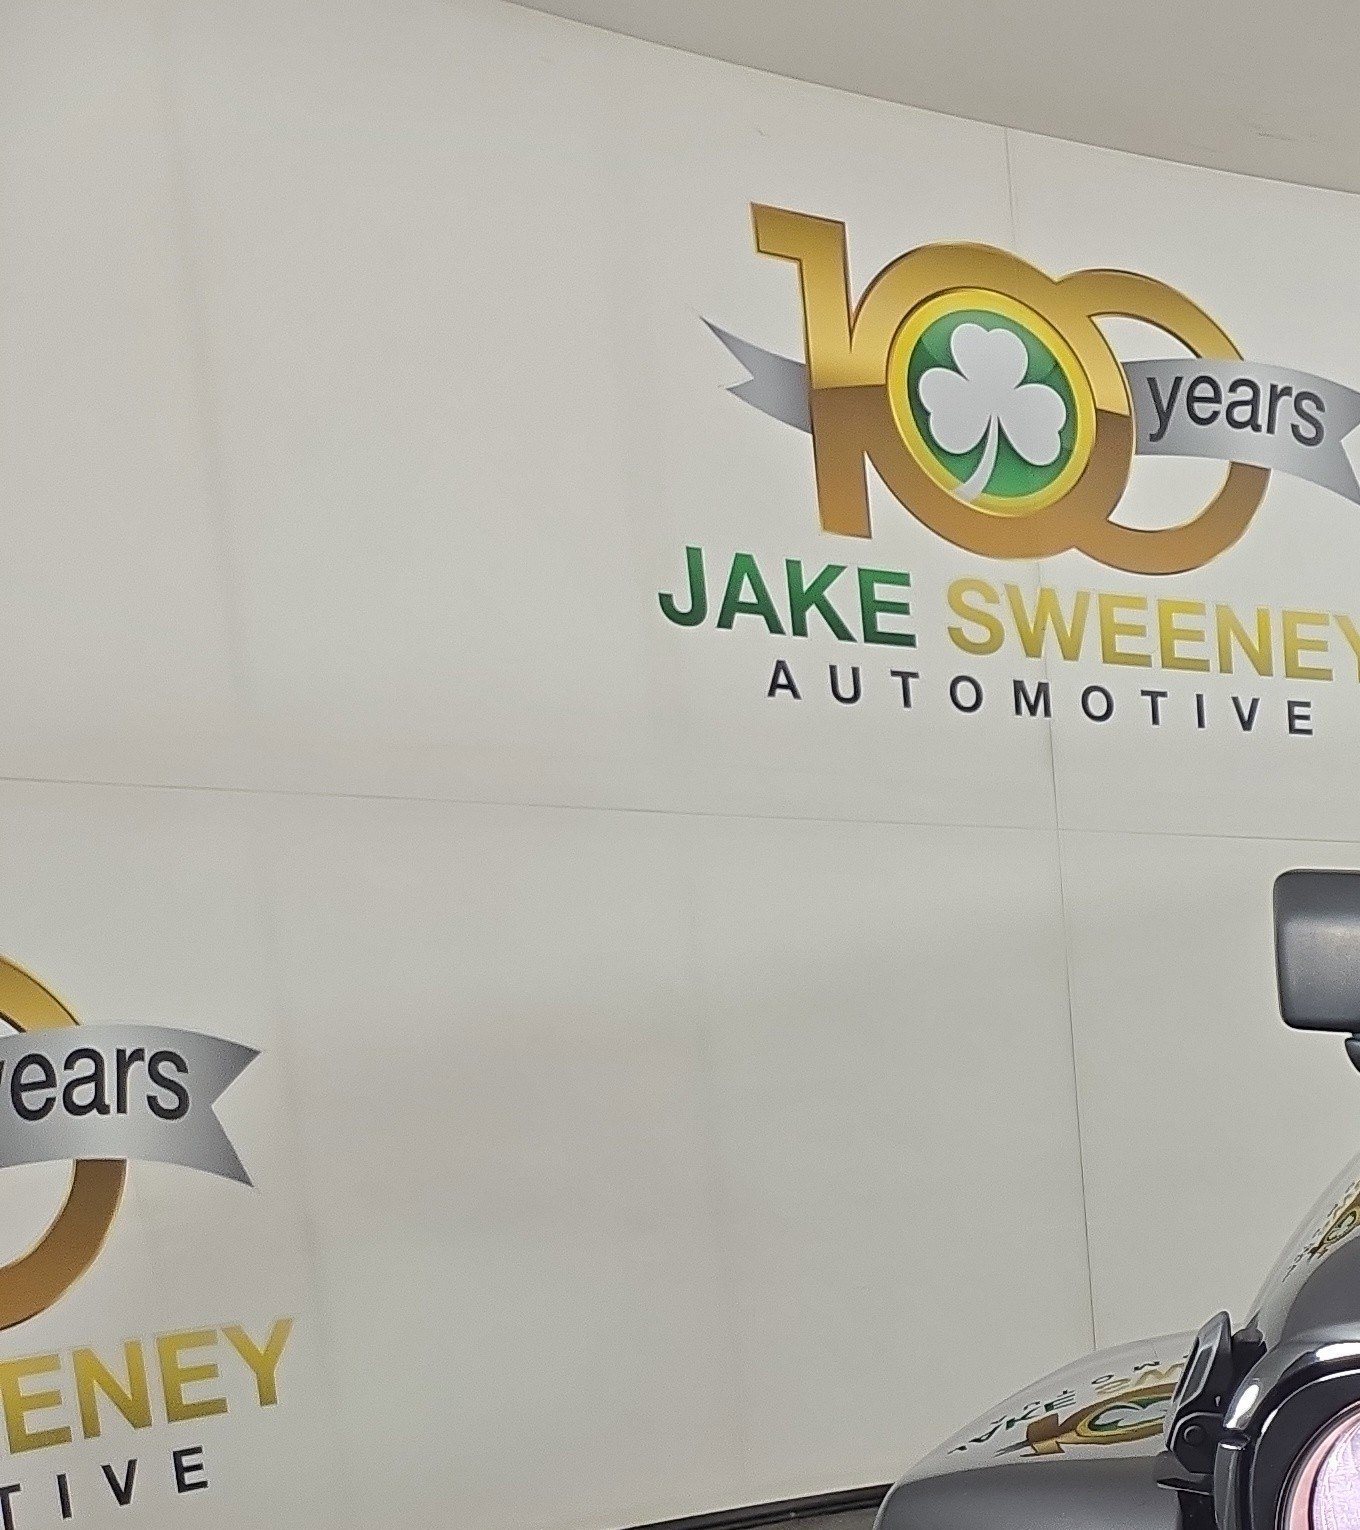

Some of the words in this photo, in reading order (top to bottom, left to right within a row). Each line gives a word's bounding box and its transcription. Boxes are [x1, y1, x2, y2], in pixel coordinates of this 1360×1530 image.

[1146, 370, 1327, 447] years
[659, 546, 917, 648] JAKE
[767, 659, 1314, 737] AUTOMOTIVE
[0, 1047, 190, 1122] ears
